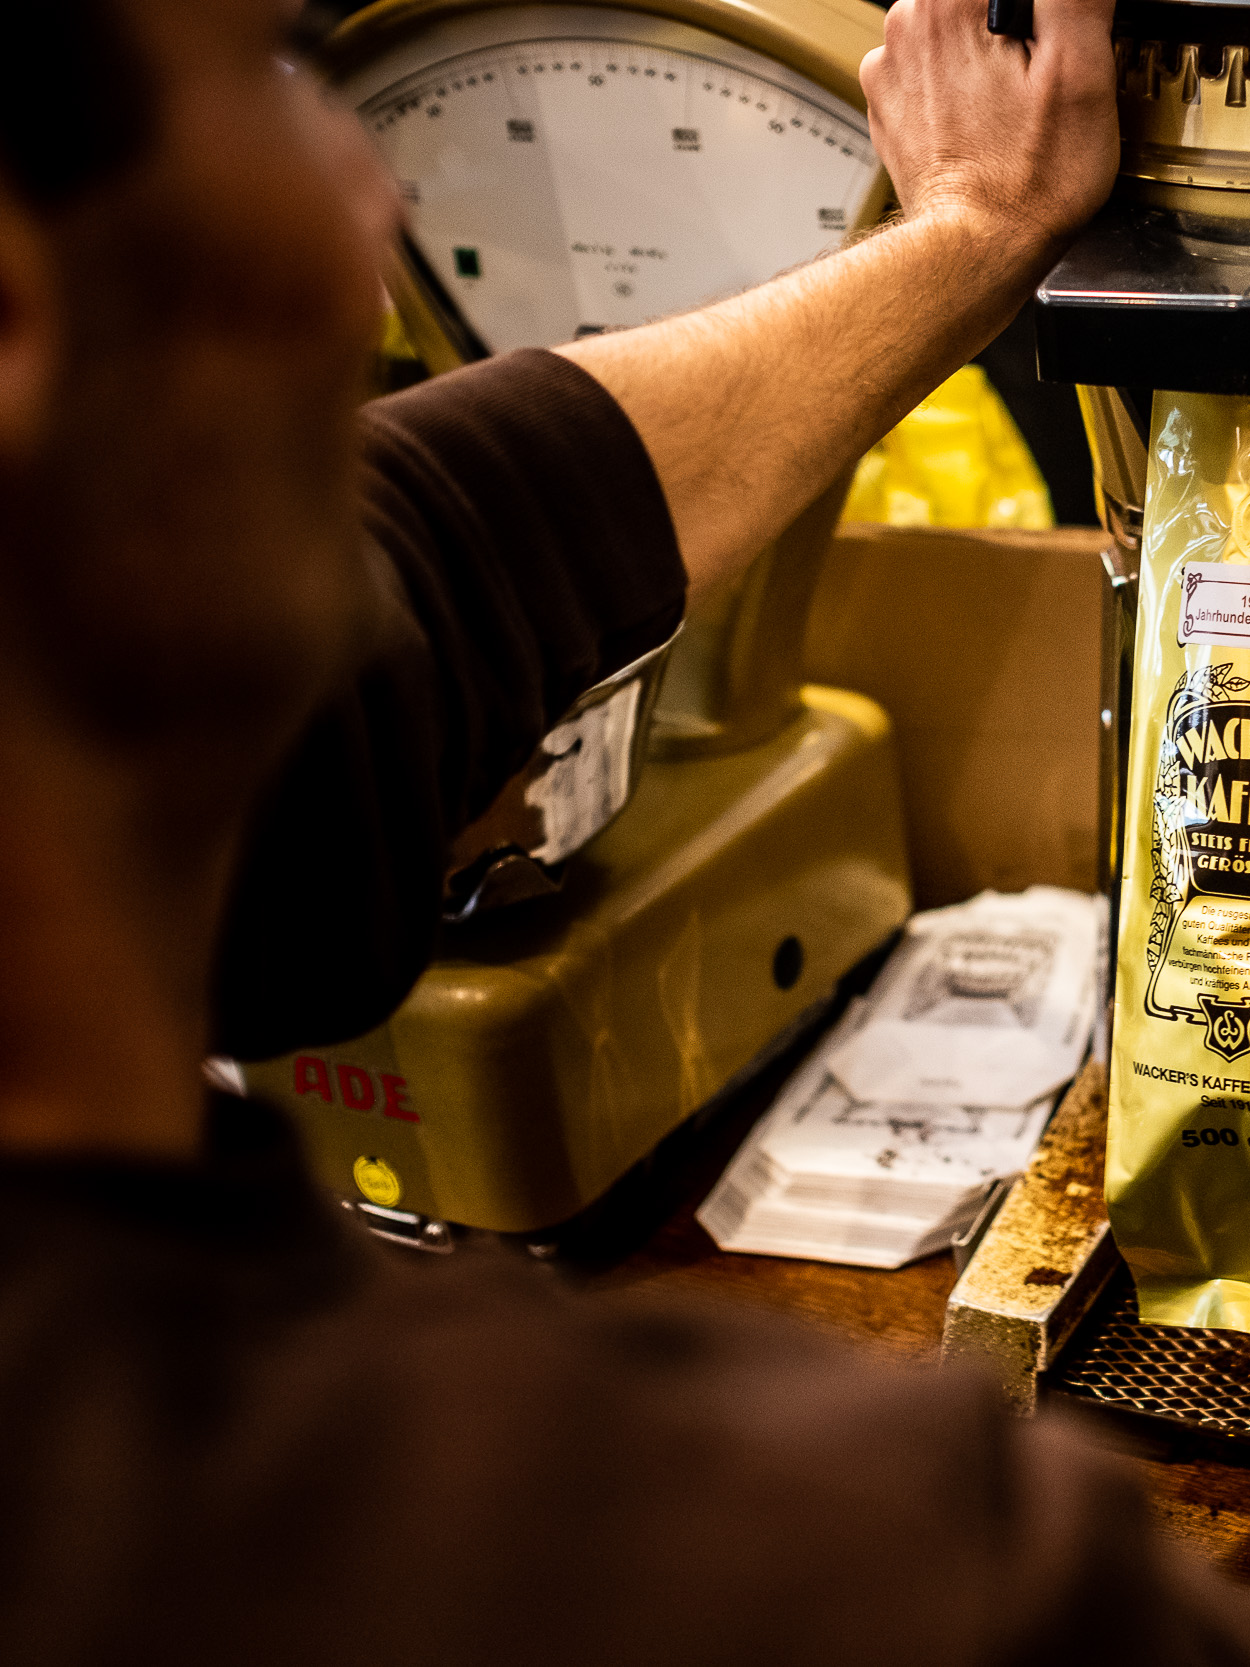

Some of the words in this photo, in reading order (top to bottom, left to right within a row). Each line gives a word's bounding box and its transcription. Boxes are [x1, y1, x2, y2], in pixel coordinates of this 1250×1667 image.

[1191, 832, 1233, 851] STETS
[1201, 905, 1216, 916] Die
[1182, 919, 1206, 930] guten
[1197, 934, 1229, 946] Kaffees
[1231, 938, 1249, 947] und
[1168, 959, 1202, 973] verbürgen
[1203, 963, 1250, 976] hochfeinen
[1190, 977, 1203, 986] und
[1205, 977, 1240, 992] kräftiges
[1133, 1060, 1199, 1087] WACKER'S
[295, 1055, 421, 1123] ADE
[1201, 1094, 1227, 1109] Seit
[1182, 1127, 1239, 1148] 500
